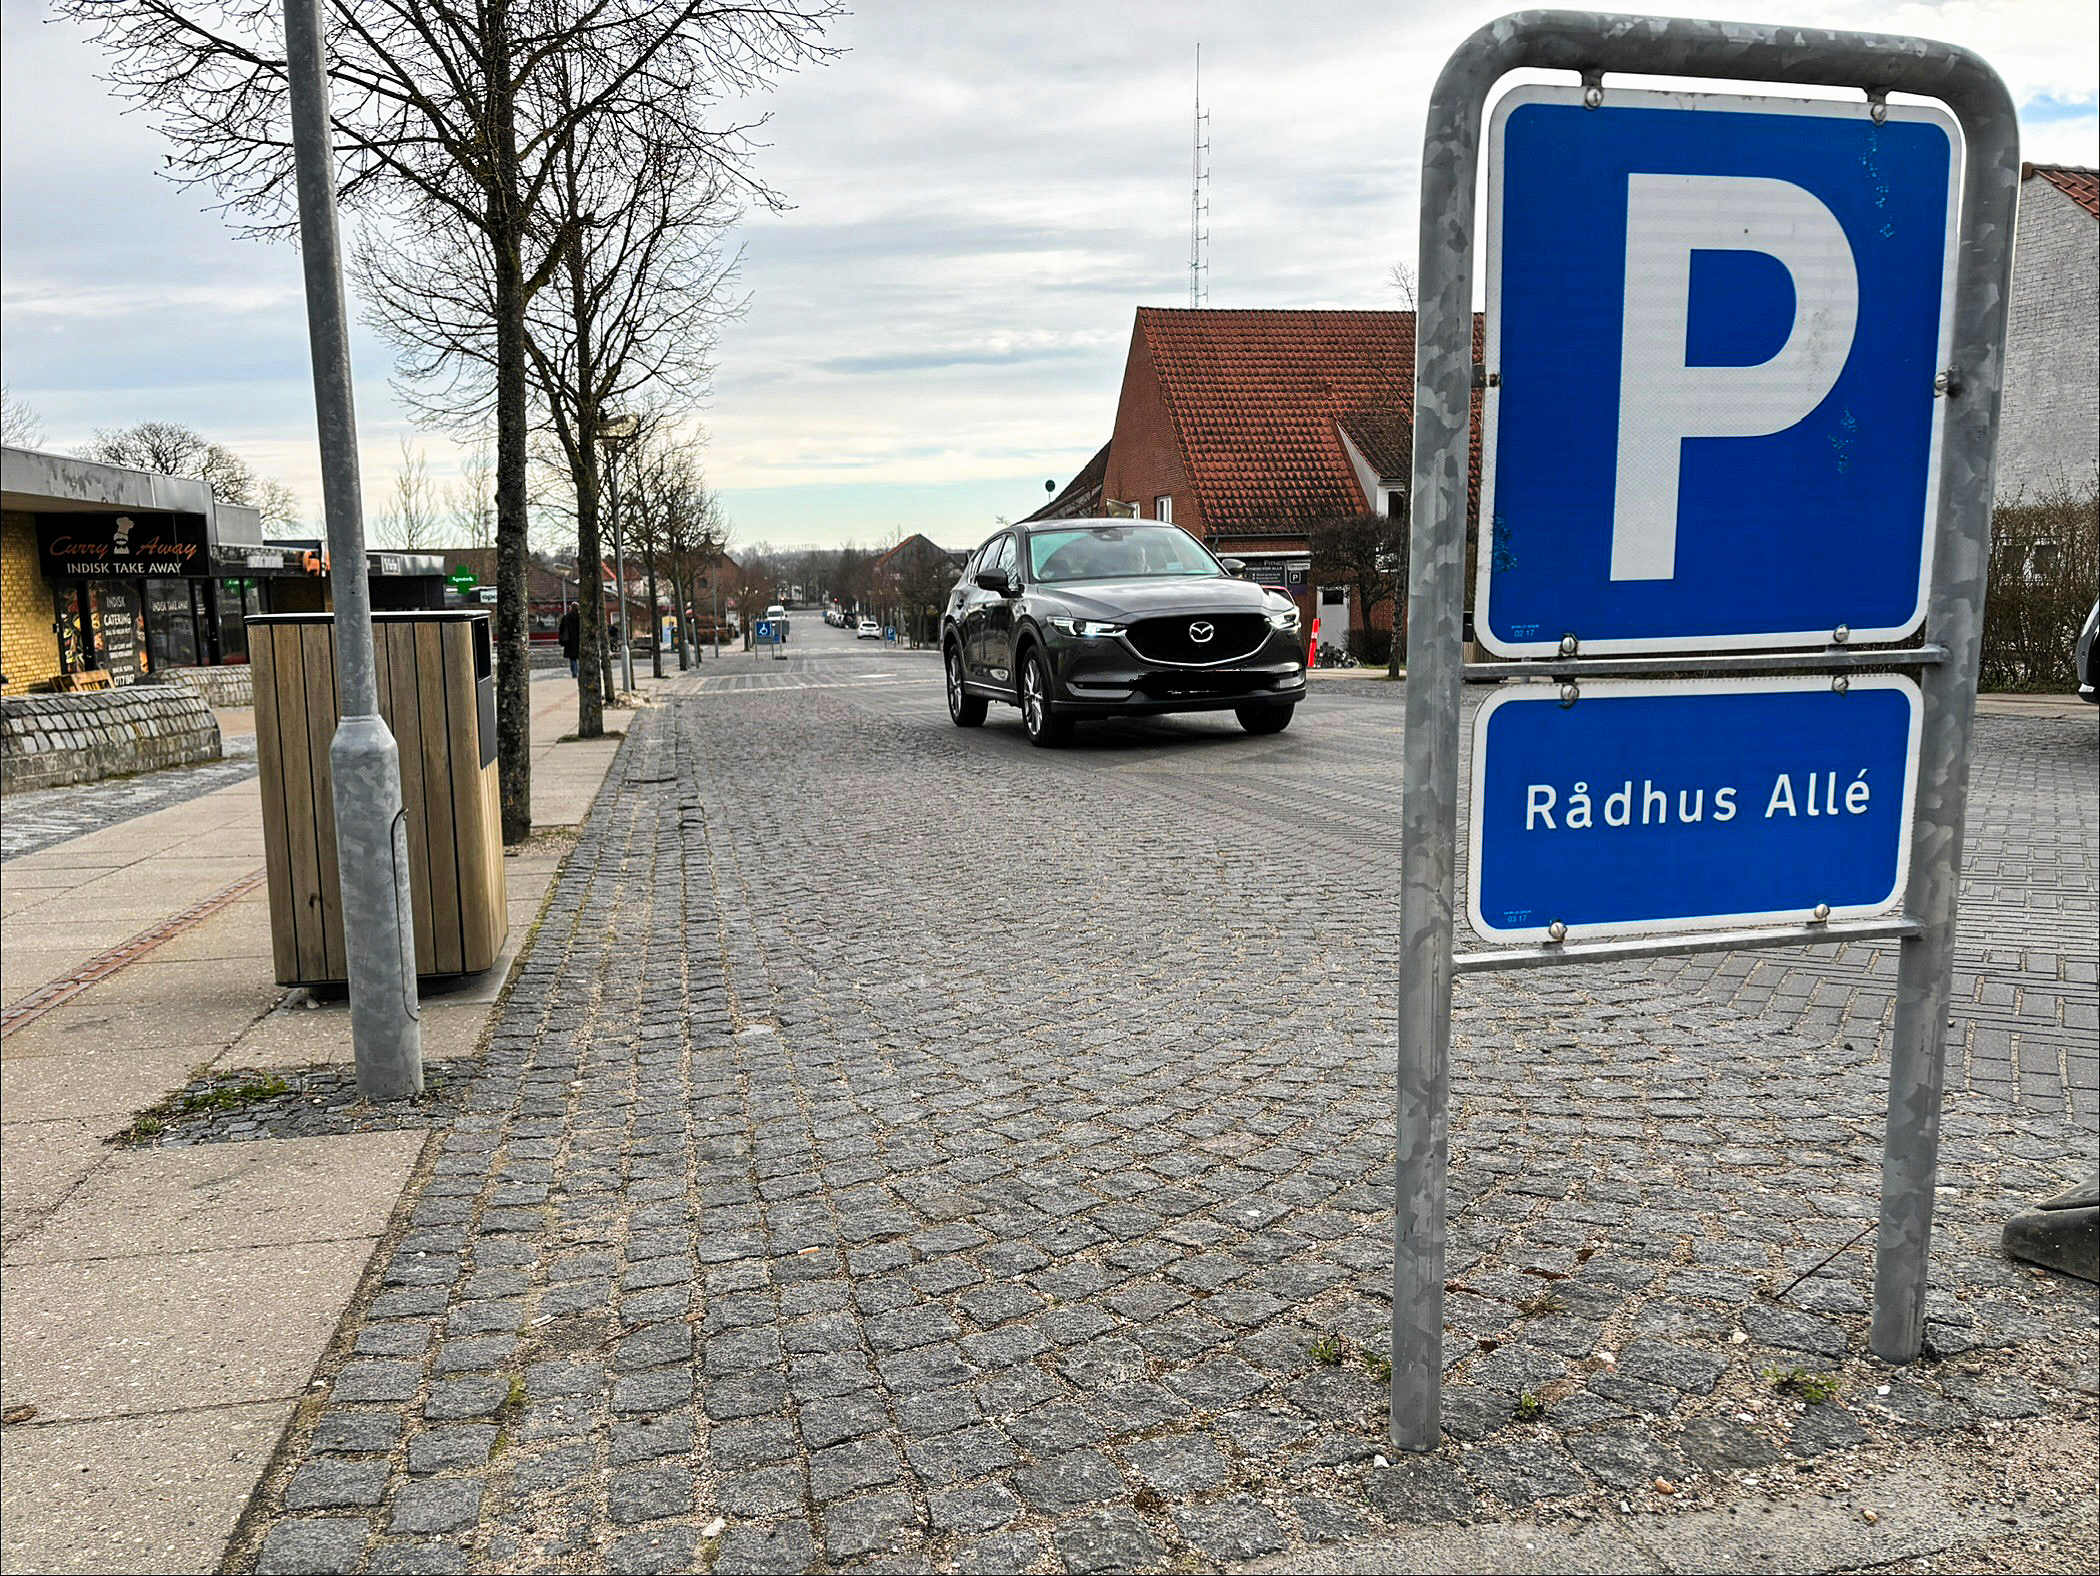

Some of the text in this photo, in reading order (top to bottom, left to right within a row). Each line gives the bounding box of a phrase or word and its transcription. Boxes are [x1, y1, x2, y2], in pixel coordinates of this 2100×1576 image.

[1610, 173, 1859, 581] P
[50, 535, 198, 561] Curry Away
[67, 562, 182, 574] INDISK TAKE AWAY
[103, 612, 132, 627] CATERING
[1526, 768, 1871, 830] Rådhus Allé
